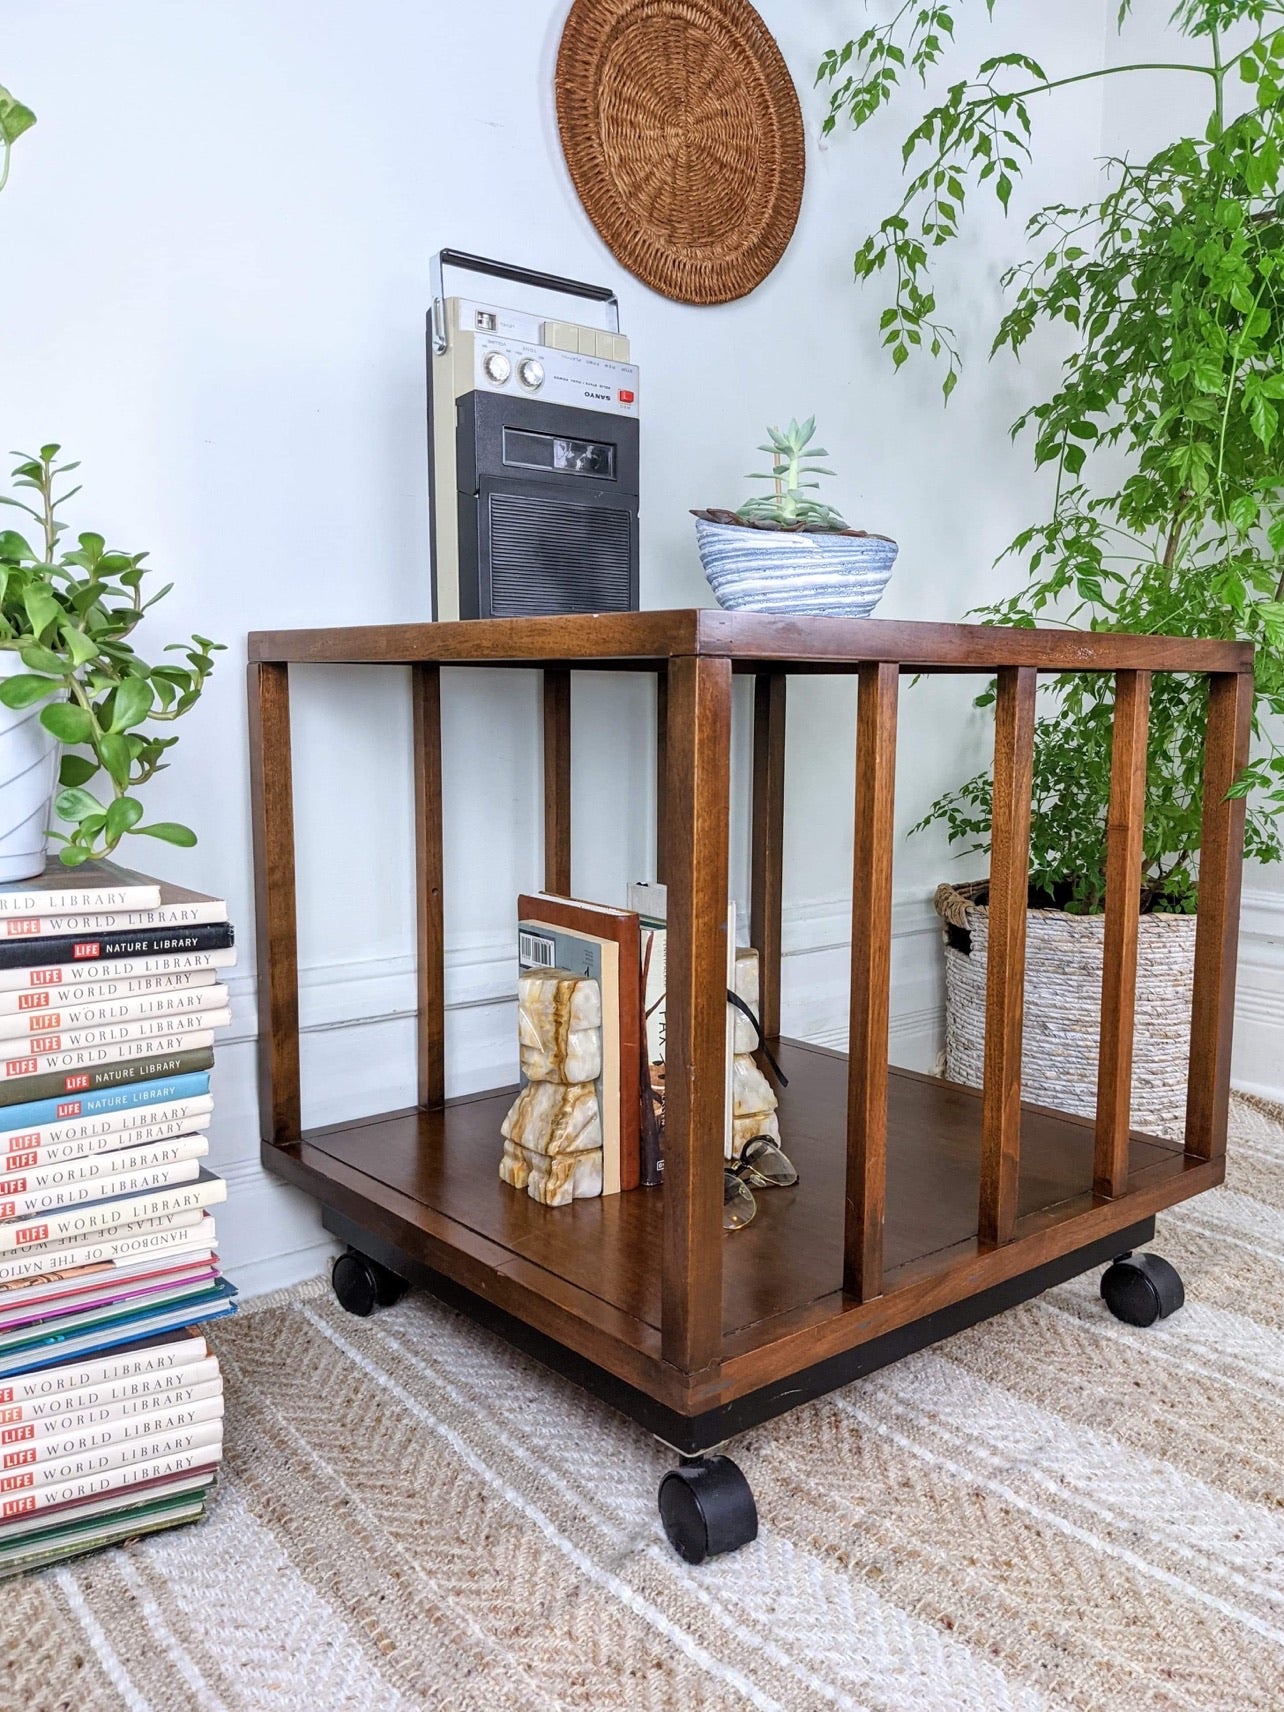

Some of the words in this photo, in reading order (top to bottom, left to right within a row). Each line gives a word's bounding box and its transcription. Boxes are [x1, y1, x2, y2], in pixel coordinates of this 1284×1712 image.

[584, 391, 611, 401] SANYO
[50, 893, 127, 907] LIBRARY
[8, 921, 39, 934] LIFE
[50, 916, 115, 930] WORLD
[128, 909, 200, 925] LIBRARY
[75, 944, 99, 957] LIFE
[106, 941, 148, 953] NATURE
[154, 938, 199, 950] LIBRARY
[31, 970, 61, 985] LIFE
[71, 963, 134, 979] WORLD
[145, 954, 212, 971] LIBRARY
[20, 993, 48, 1009] LIFE
[58, 984, 117, 1001] WORLD
[128, 973, 192, 991] LIBRARY
[30, 1015, 59, 1030] LIFE
[69, 1006, 129, 1023] WORLD
[140, 995, 203, 1012] LIBRARY
[32, 1037, 60, 1052] LIFE
[70, 1027, 129, 1046] WORLD
[140, 1016, 203, 1035] LIBRARY
[7, 1061, 36, 1076] LIFE
[46, 1049, 107, 1068] WORLD
[118, 1037, 184, 1056] LIBRARY
[66, 1076, 89, 1090] LIFE
[95, 1067, 135, 1083] NATURE
[140, 1060, 181, 1075] LIBRARY
[58, 1102, 80, 1117] LIFE
[87, 1095, 127, 1110] NATURE
[133, 1087, 175, 1102] LIBRARY
[7, 1152, 36, 1170] LIFE
[47, 1139, 107, 1160] WORLD
[118, 1121, 184, 1144] LIBRARY
[11, 1134, 39, 1150] LIFE
[50, 1122, 111, 1142] WORLD
[122, 1107, 189, 1128] LIBRARY
[0, 1179, 25, 1195] LIFE
[36, 1165, 99, 1186] WORLD
[111, 1148, 179, 1171] LIBRARY
[24, 1189, 88, 1211] WORLD
[101, 1172, 170, 1195] LIBRARY
[17, 1225, 47, 1244] LIFE
[58, 1211, 120, 1233] WORLD
[133, 1193, 202, 1218] LIBRARY
[85, 1248, 103, 1261] OF
[112, 1230, 188, 1255] HANDBOOK
[50, 1254, 77, 1268] THE
[23, 1373, 90, 1396] WORLD
[103, 1354, 176, 1379] LIBRARY
[32, 1393, 99, 1416] WORLD
[111, 1374, 185, 1398] LIBRARY
[3, 1425, 33, 1443] LIFE
[44, 1409, 110, 1432] WORLD
[122, 1389, 194, 1414] LIBRARY
[5, 1449, 35, 1467] LIFE
[46, 1432, 112, 1455] WORLD
[124, 1411, 197, 1437] LIBRARY
[2, 1474, 32, 1491] LIFE
[43, 1457, 109, 1480] WORLD
[122, 1435, 194, 1461] LIBRARY
[3, 1498, 35, 1515] LIFE
[45, 1479, 110, 1503] WORLD
[123, 1456, 194, 1484] LIBRARY
